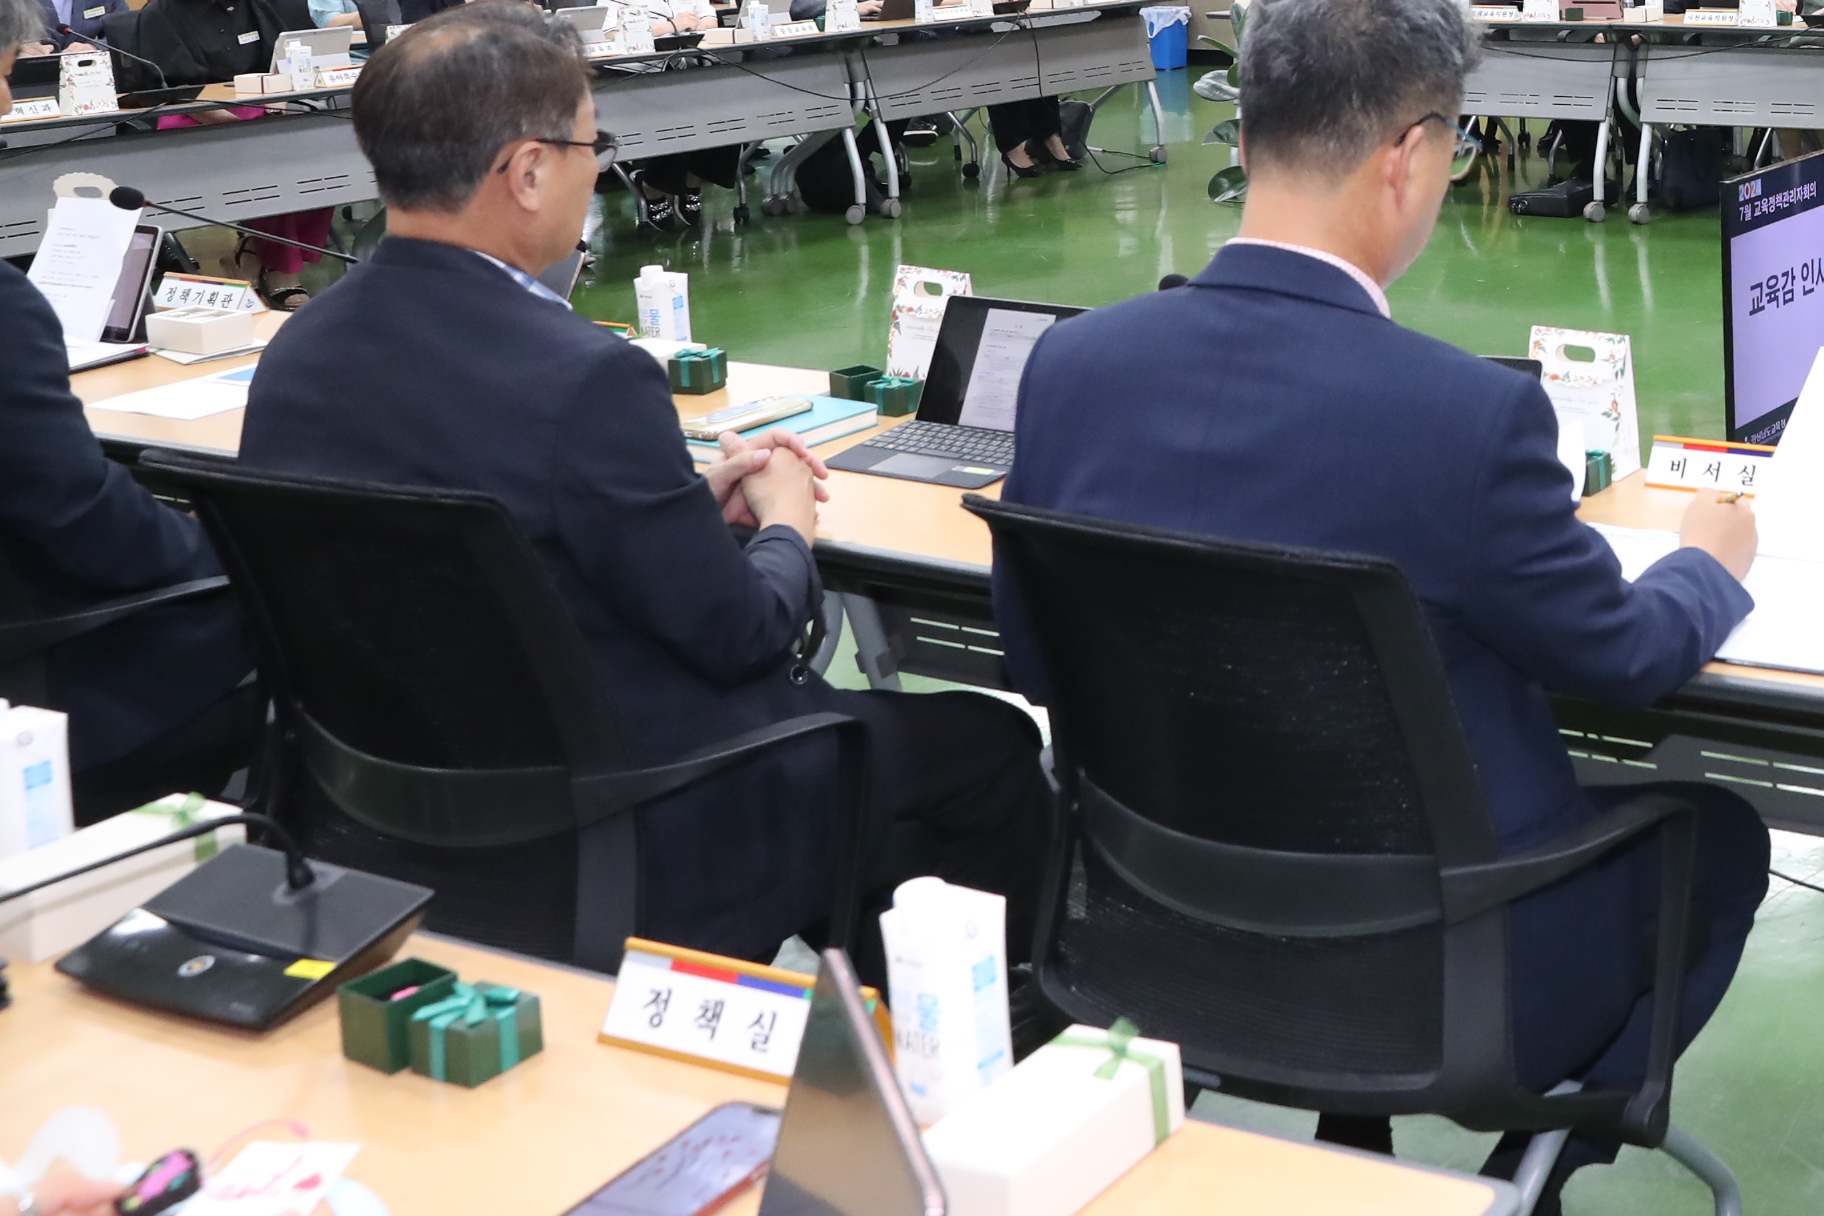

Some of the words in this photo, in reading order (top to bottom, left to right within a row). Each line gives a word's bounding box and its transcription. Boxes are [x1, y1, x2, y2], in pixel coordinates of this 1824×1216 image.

[1738, 178, 1762, 202] 202
[1739, 203, 1752, 221] 7월
[1753, 180, 1817, 216] 교육정책관리자회의
[165, 286, 234, 309] 정책기획관
[1749, 267, 1796, 316] 교육감
[1670, 457, 1756, 487] 비서실
[642, 987, 778, 1054] 정책실
